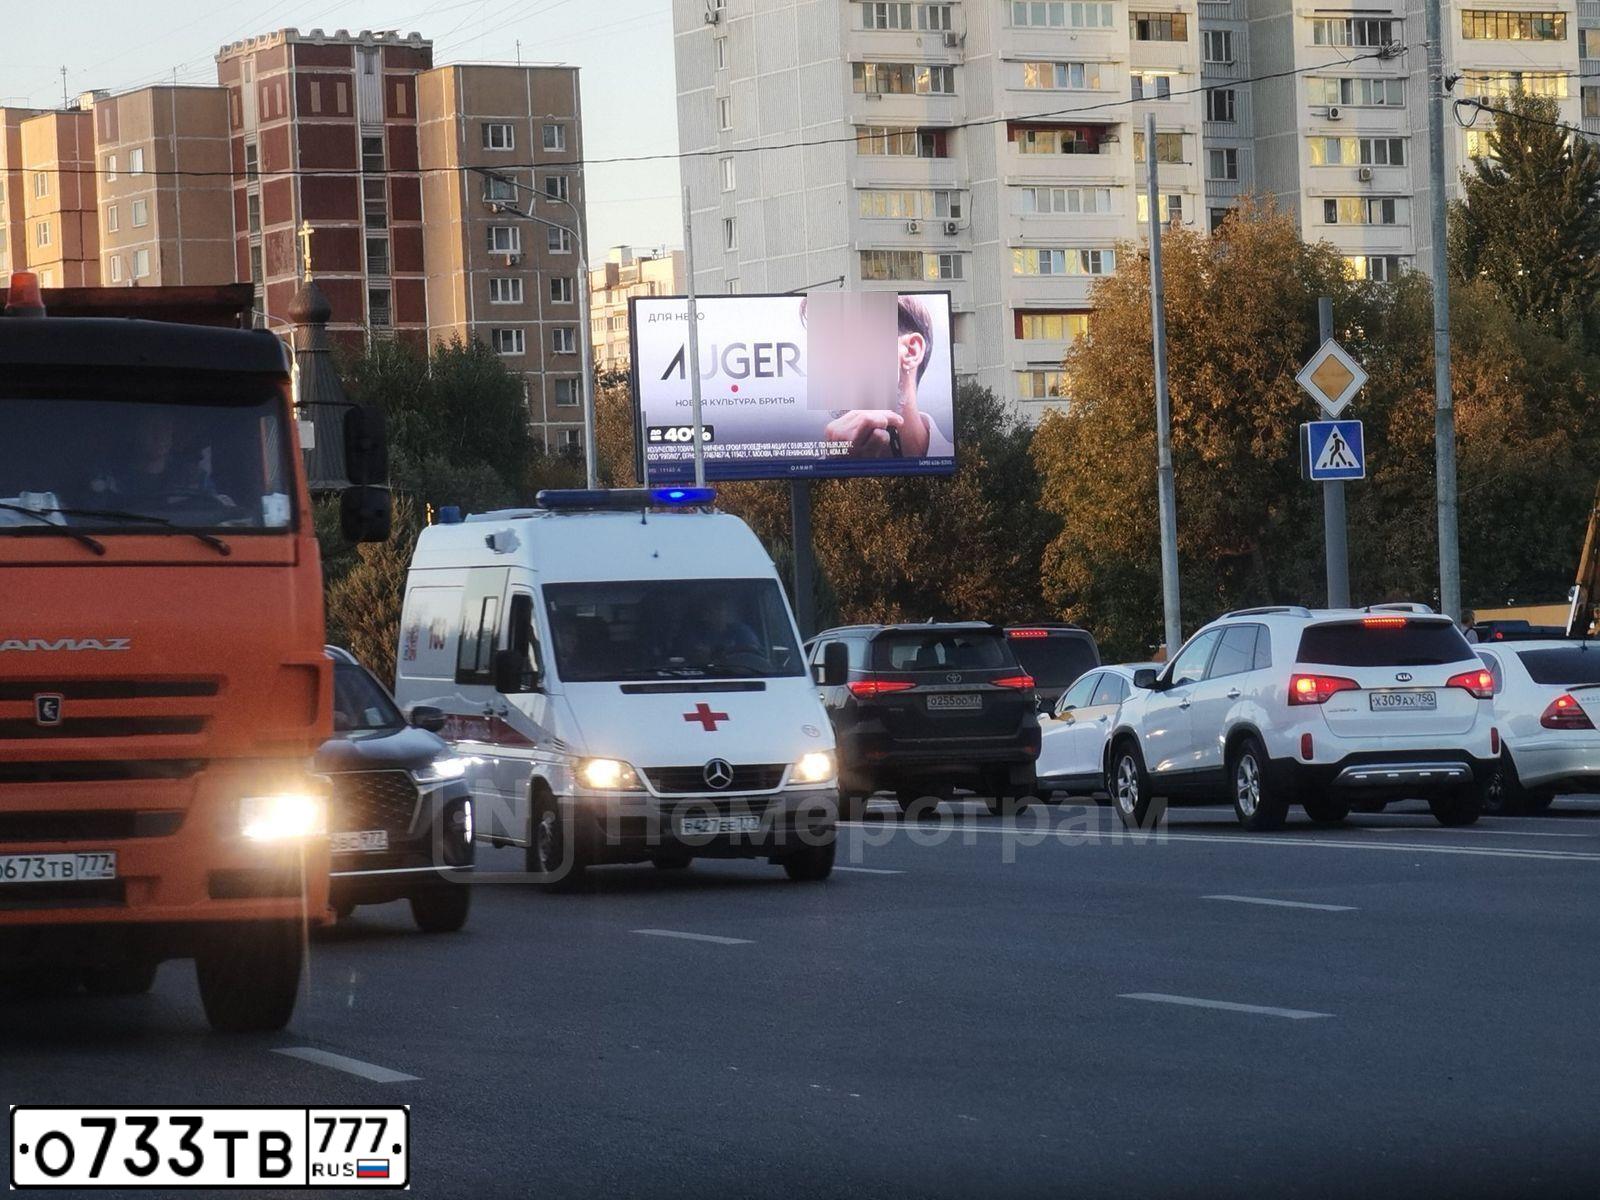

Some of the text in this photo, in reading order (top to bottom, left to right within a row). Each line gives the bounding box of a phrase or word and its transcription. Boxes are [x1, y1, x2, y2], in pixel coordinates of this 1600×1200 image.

[648, 311, 705, 322] ДЛЯ НЕО
[709, 398, 756, 406] КУЛЬТУРА
[758, 396, 795, 405] БРИТЬЯ
[0, 638, 131, 650] AMAZ
[1374, 694, 1415, 706] Х309АХ
[0, 855, 110, 879] 673ТВ 777
